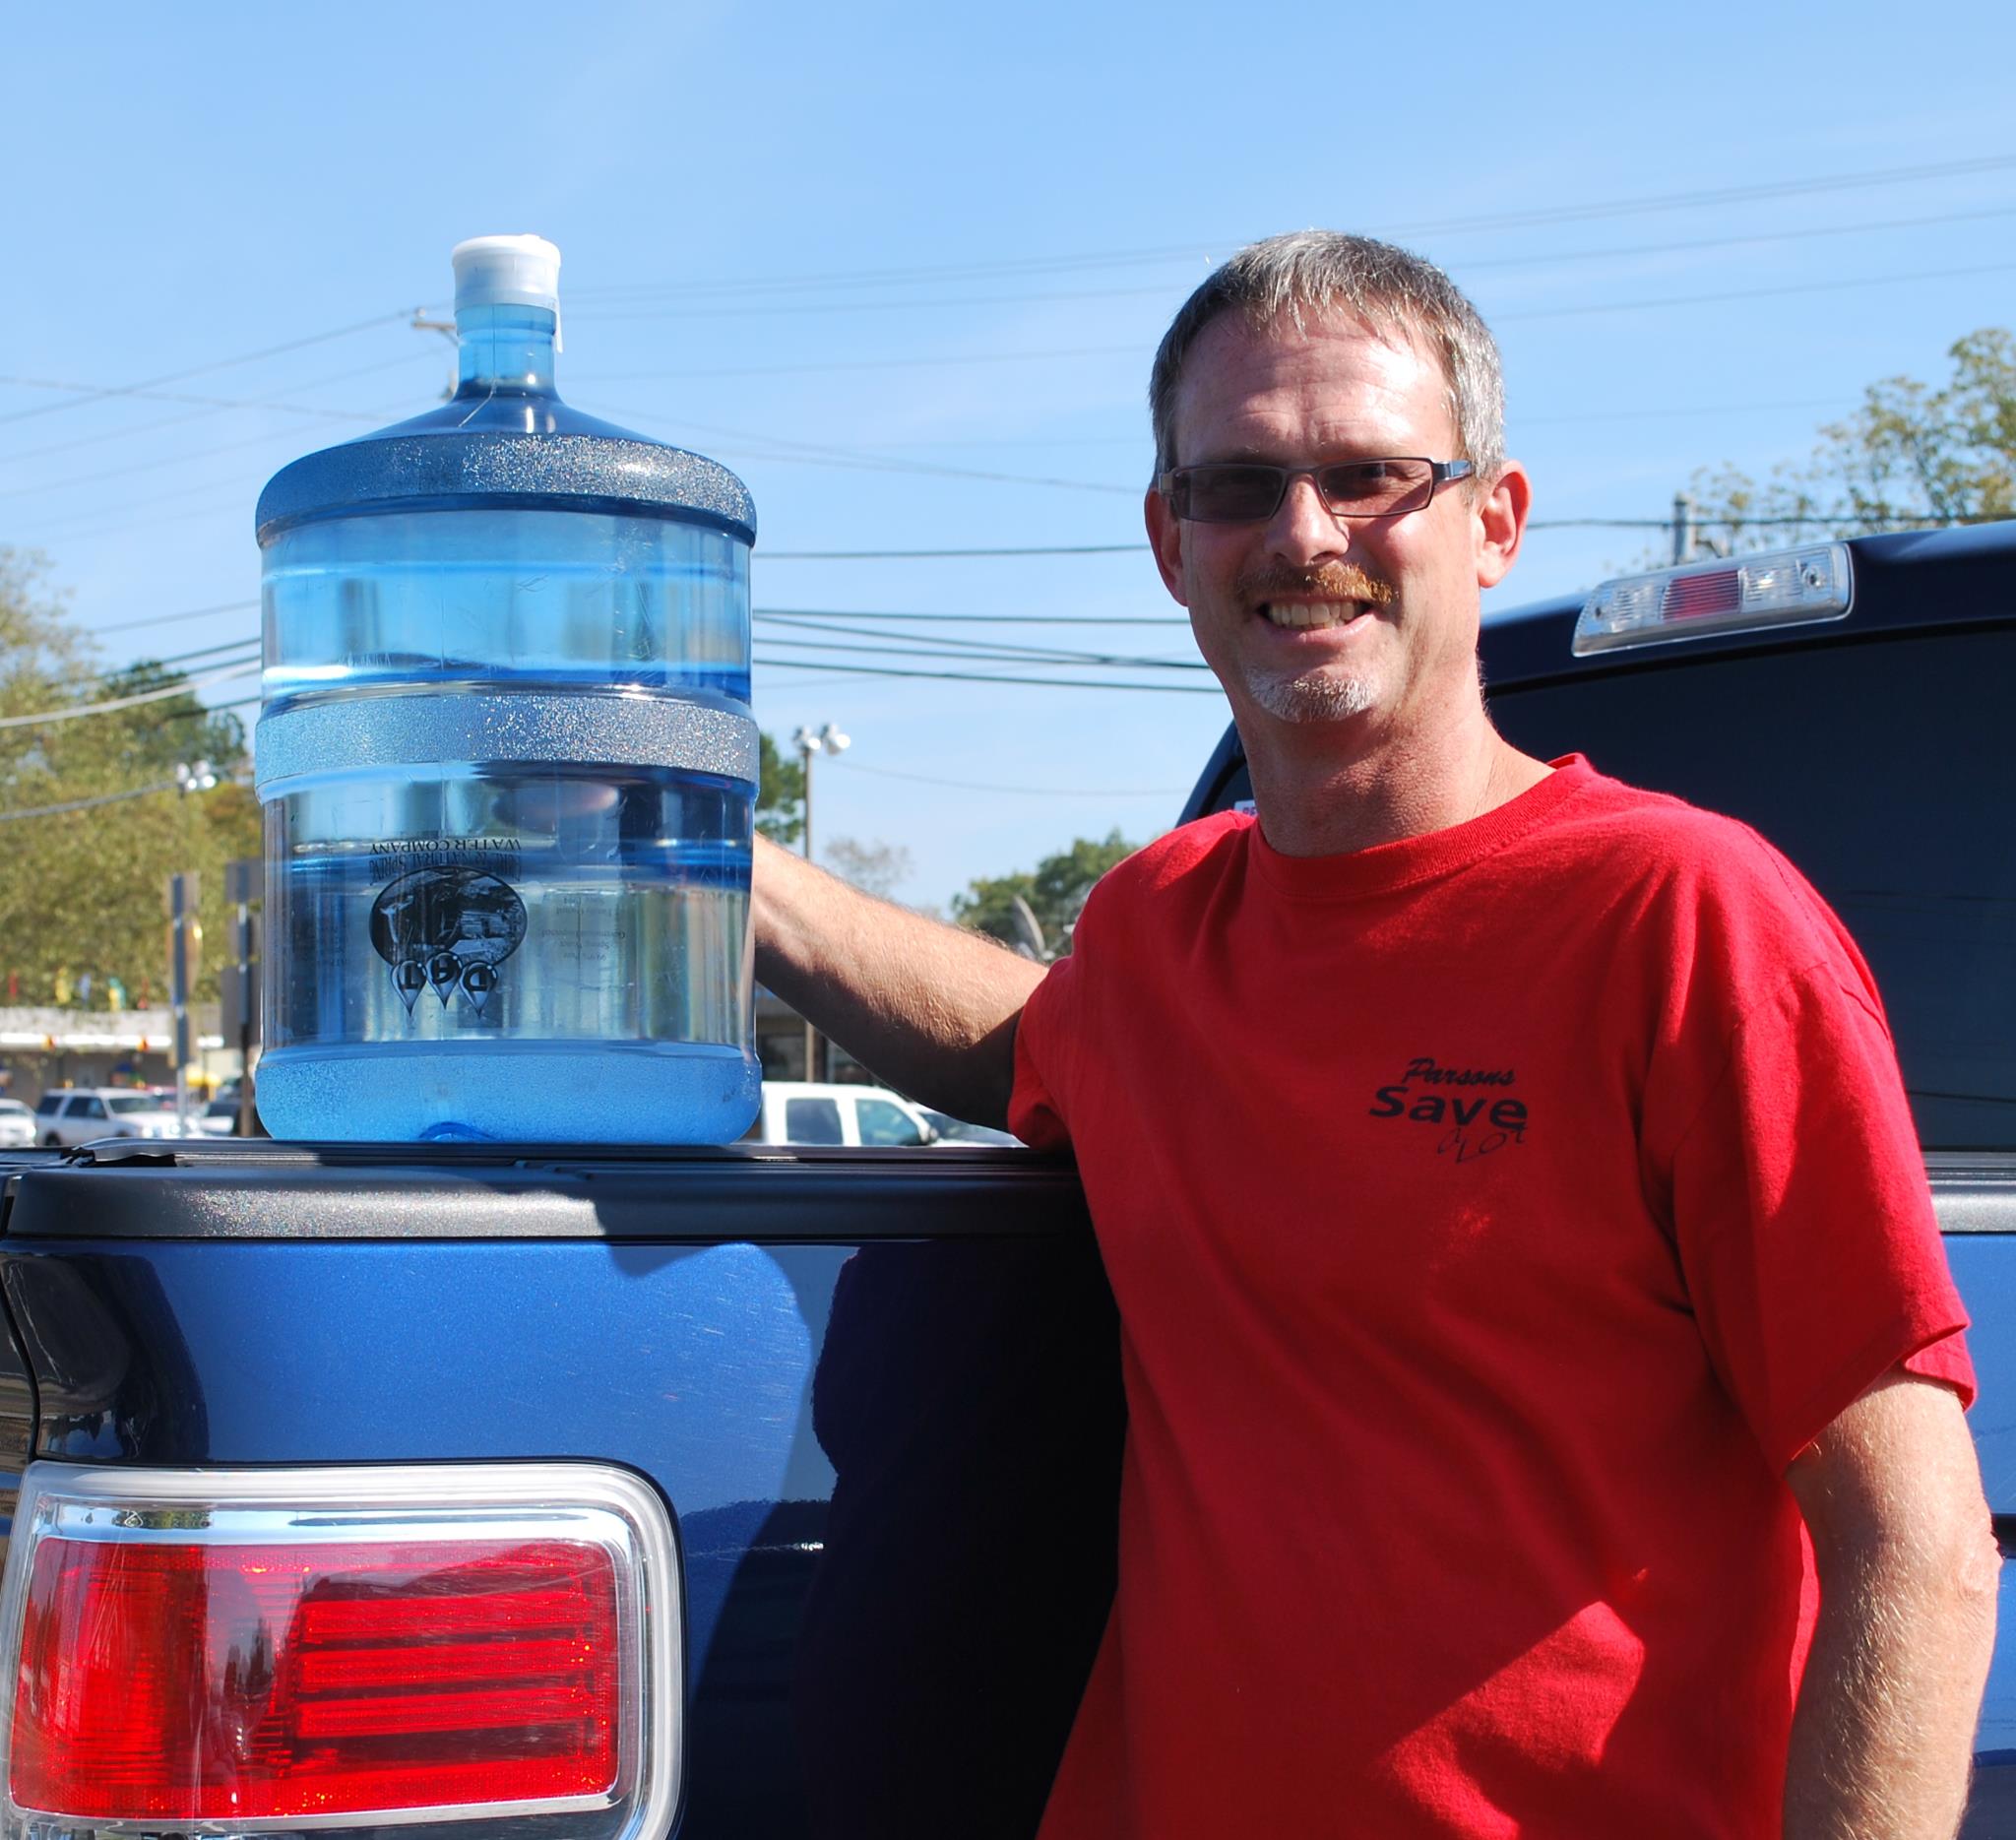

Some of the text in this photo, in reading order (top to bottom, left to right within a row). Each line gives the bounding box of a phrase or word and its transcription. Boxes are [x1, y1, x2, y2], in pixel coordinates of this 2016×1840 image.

[369, 838, 522, 855] WATER COMPANY
[1401, 1057, 1515, 1085] Parsons
[1369, 1086, 1529, 1131] Save
